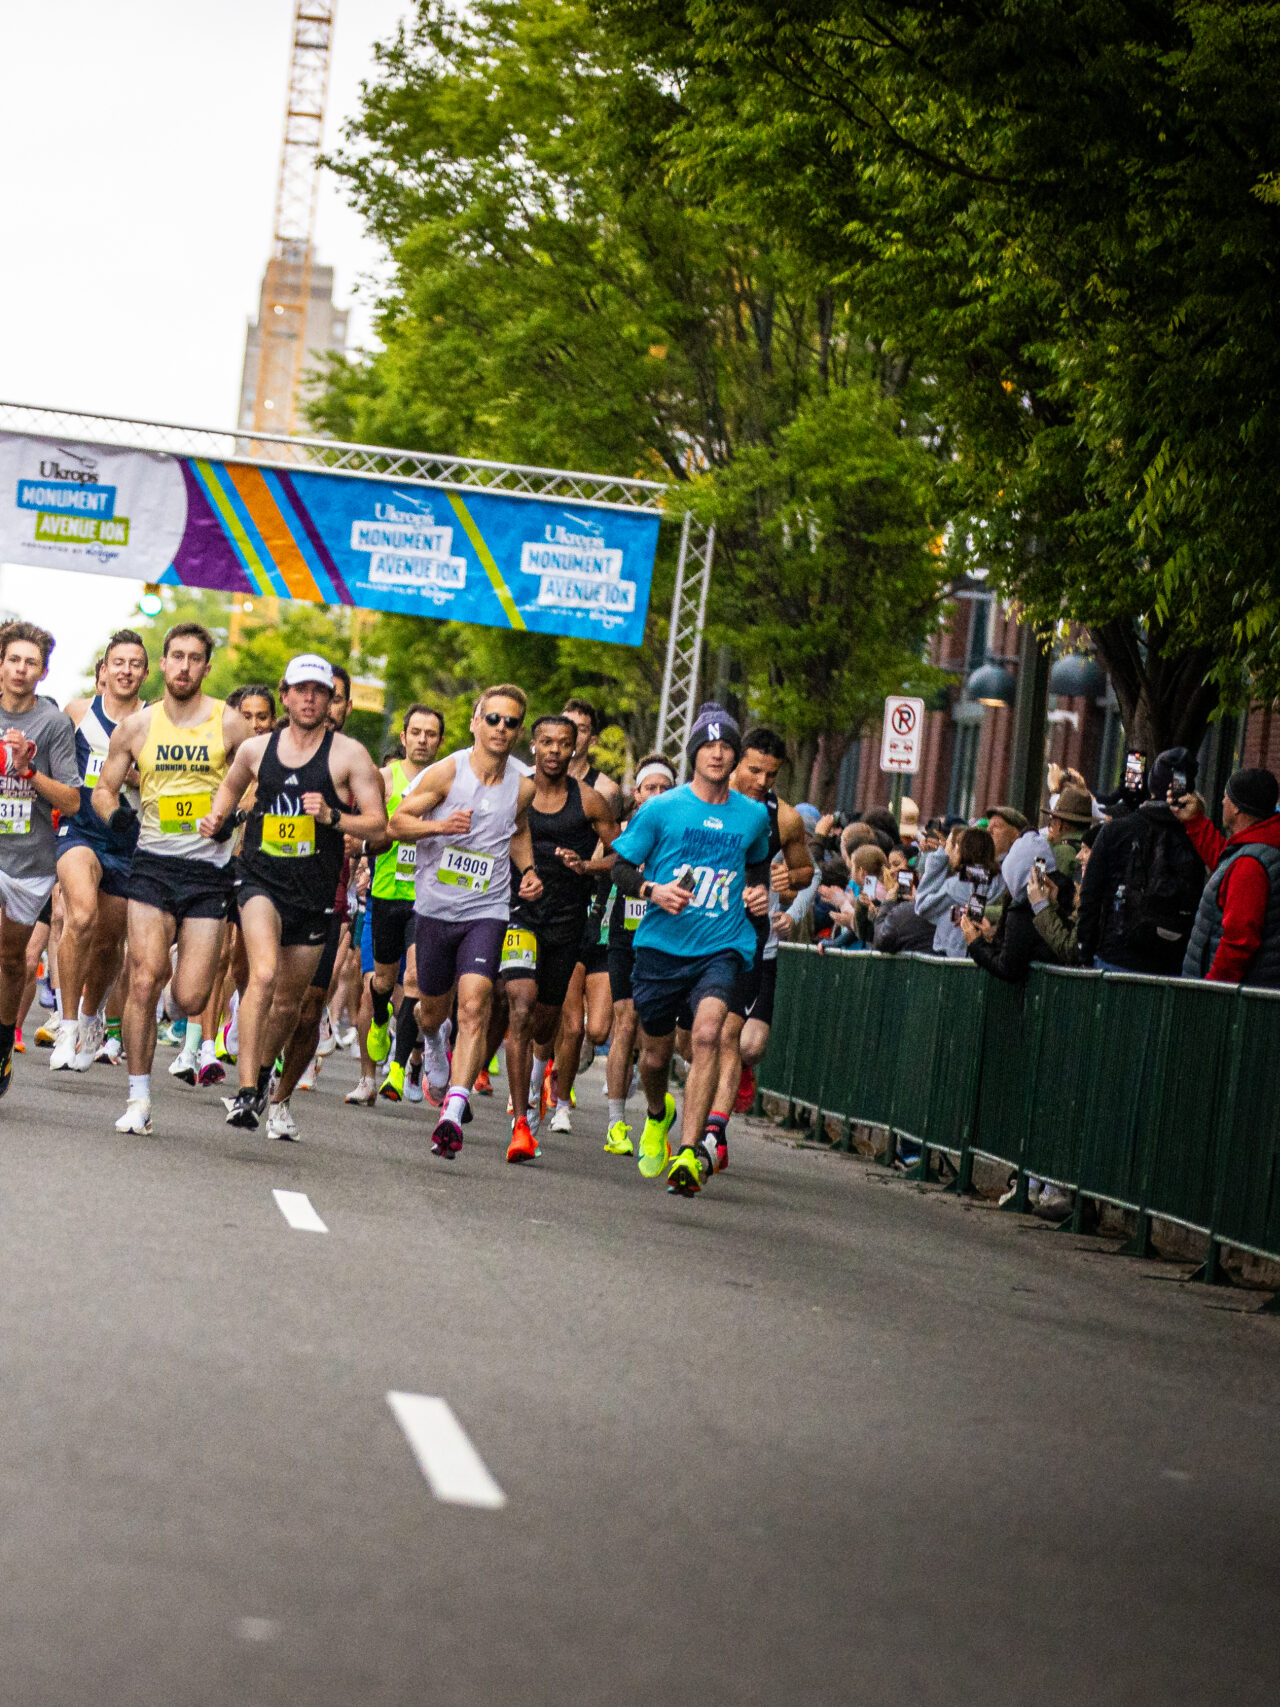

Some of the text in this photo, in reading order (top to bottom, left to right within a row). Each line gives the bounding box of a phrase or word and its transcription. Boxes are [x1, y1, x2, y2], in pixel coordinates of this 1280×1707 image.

[40, 461, 99, 487] Ukrops
[21, 486, 108, 511] MONUMENT
[39, 515, 97, 539] AVENUE
[357, 528, 442, 551] MONUMENT
[375, 557, 431, 579] AVENUE
[528, 549, 612, 574] MONUMENT
[545, 579, 600, 601] AVENUE
[707, 722, 720, 741] N
[156, 744, 210, 761] NOVA
[155, 763, 210, 772] RUNNING CLUB
[176, 801, 193, 817] 92
[278, 823, 296, 839] 82
[448, 853, 489, 877] 14909
[506, 934, 520, 947] 81
